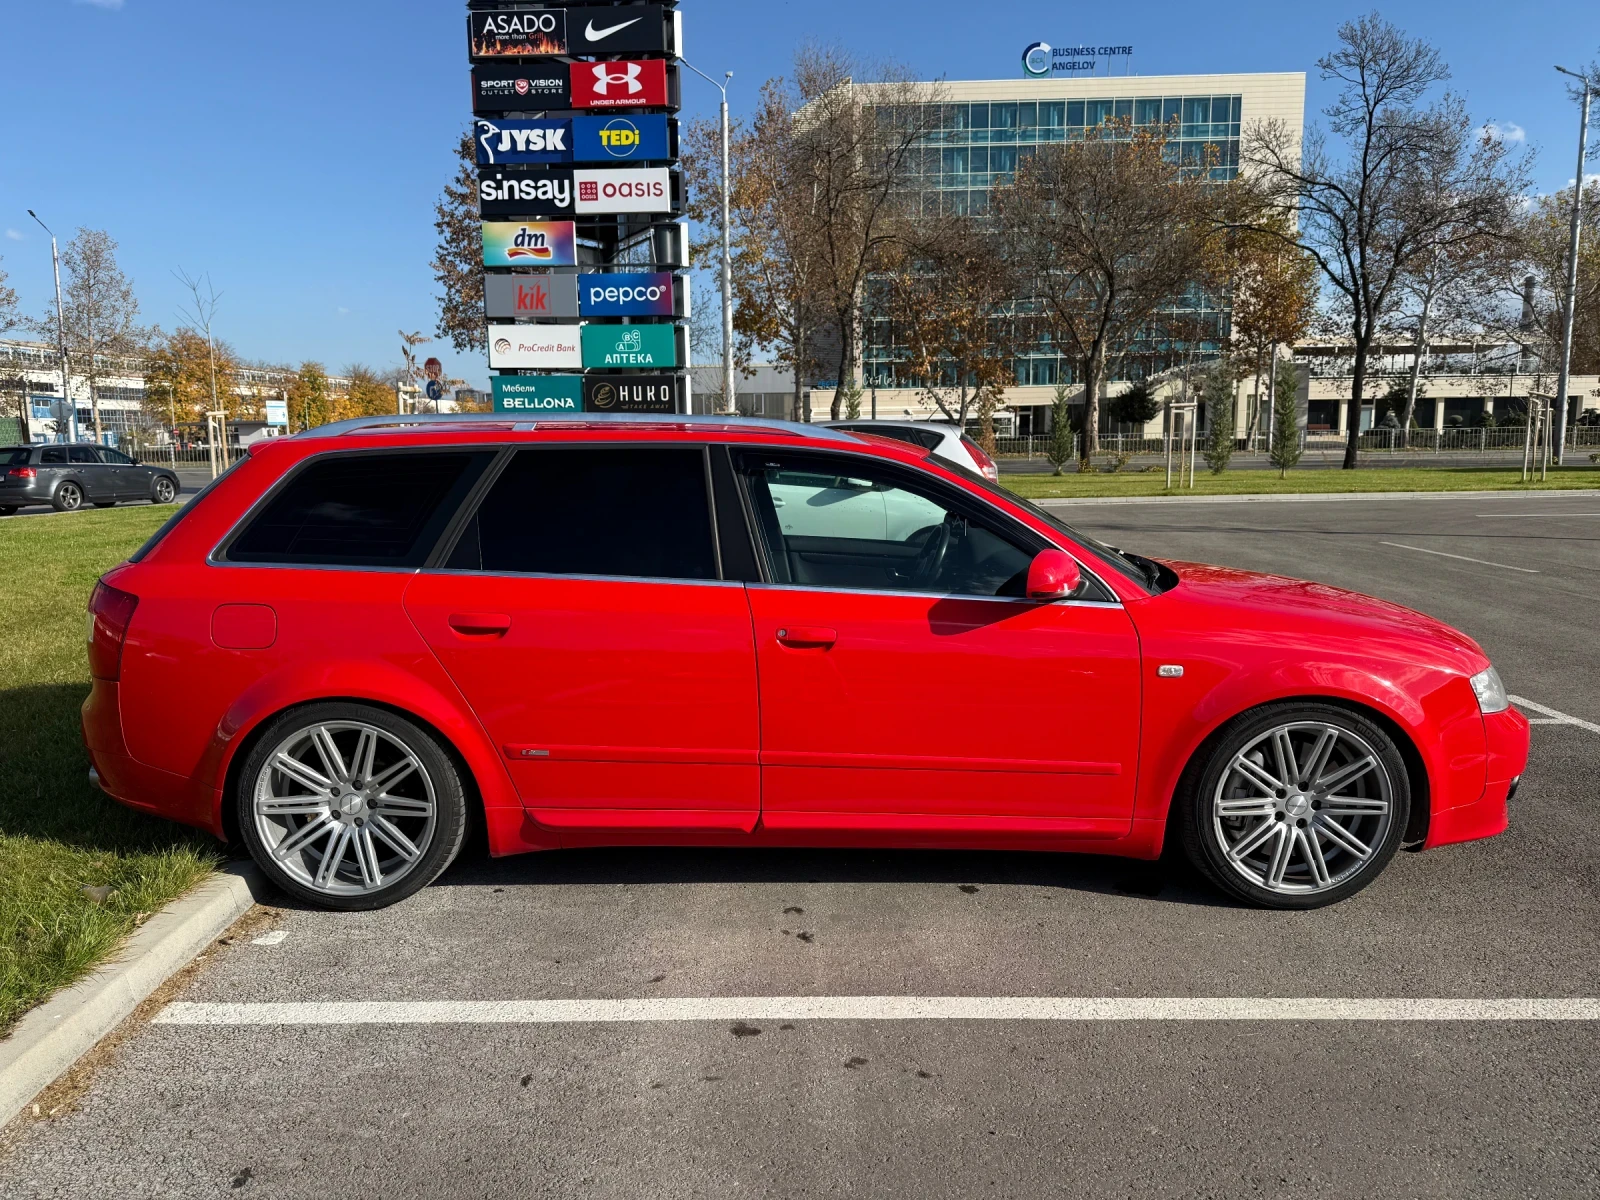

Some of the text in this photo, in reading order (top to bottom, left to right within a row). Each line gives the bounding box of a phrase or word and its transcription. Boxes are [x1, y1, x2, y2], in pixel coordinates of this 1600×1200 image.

[483, 14, 556, 33] ASADO
[528, 32, 544, 40] Grill
[1052, 46, 1133, 57] BUSINESS CENTRE
[1051, 61, 1096, 71] ANGELOV
[480, 80, 514, 88] SPORT
[529, 79, 563, 87] VISION
[497, 128, 566, 151] JYSK
[599, 130, 640, 146] TEDi
[480, 173, 570, 207] sinsay
[602, 181, 664, 198] oasis
[514, 228, 545, 247] dm
[517, 283, 547, 310] kik
[518, 343, 576, 352] ProCredit Bank
[604, 353, 653, 364] АПТЕКА
[425, 364, 440, 373] STOP
[502, 384, 536, 393] Мебели
[503, 397, 575, 409] BELLONA
